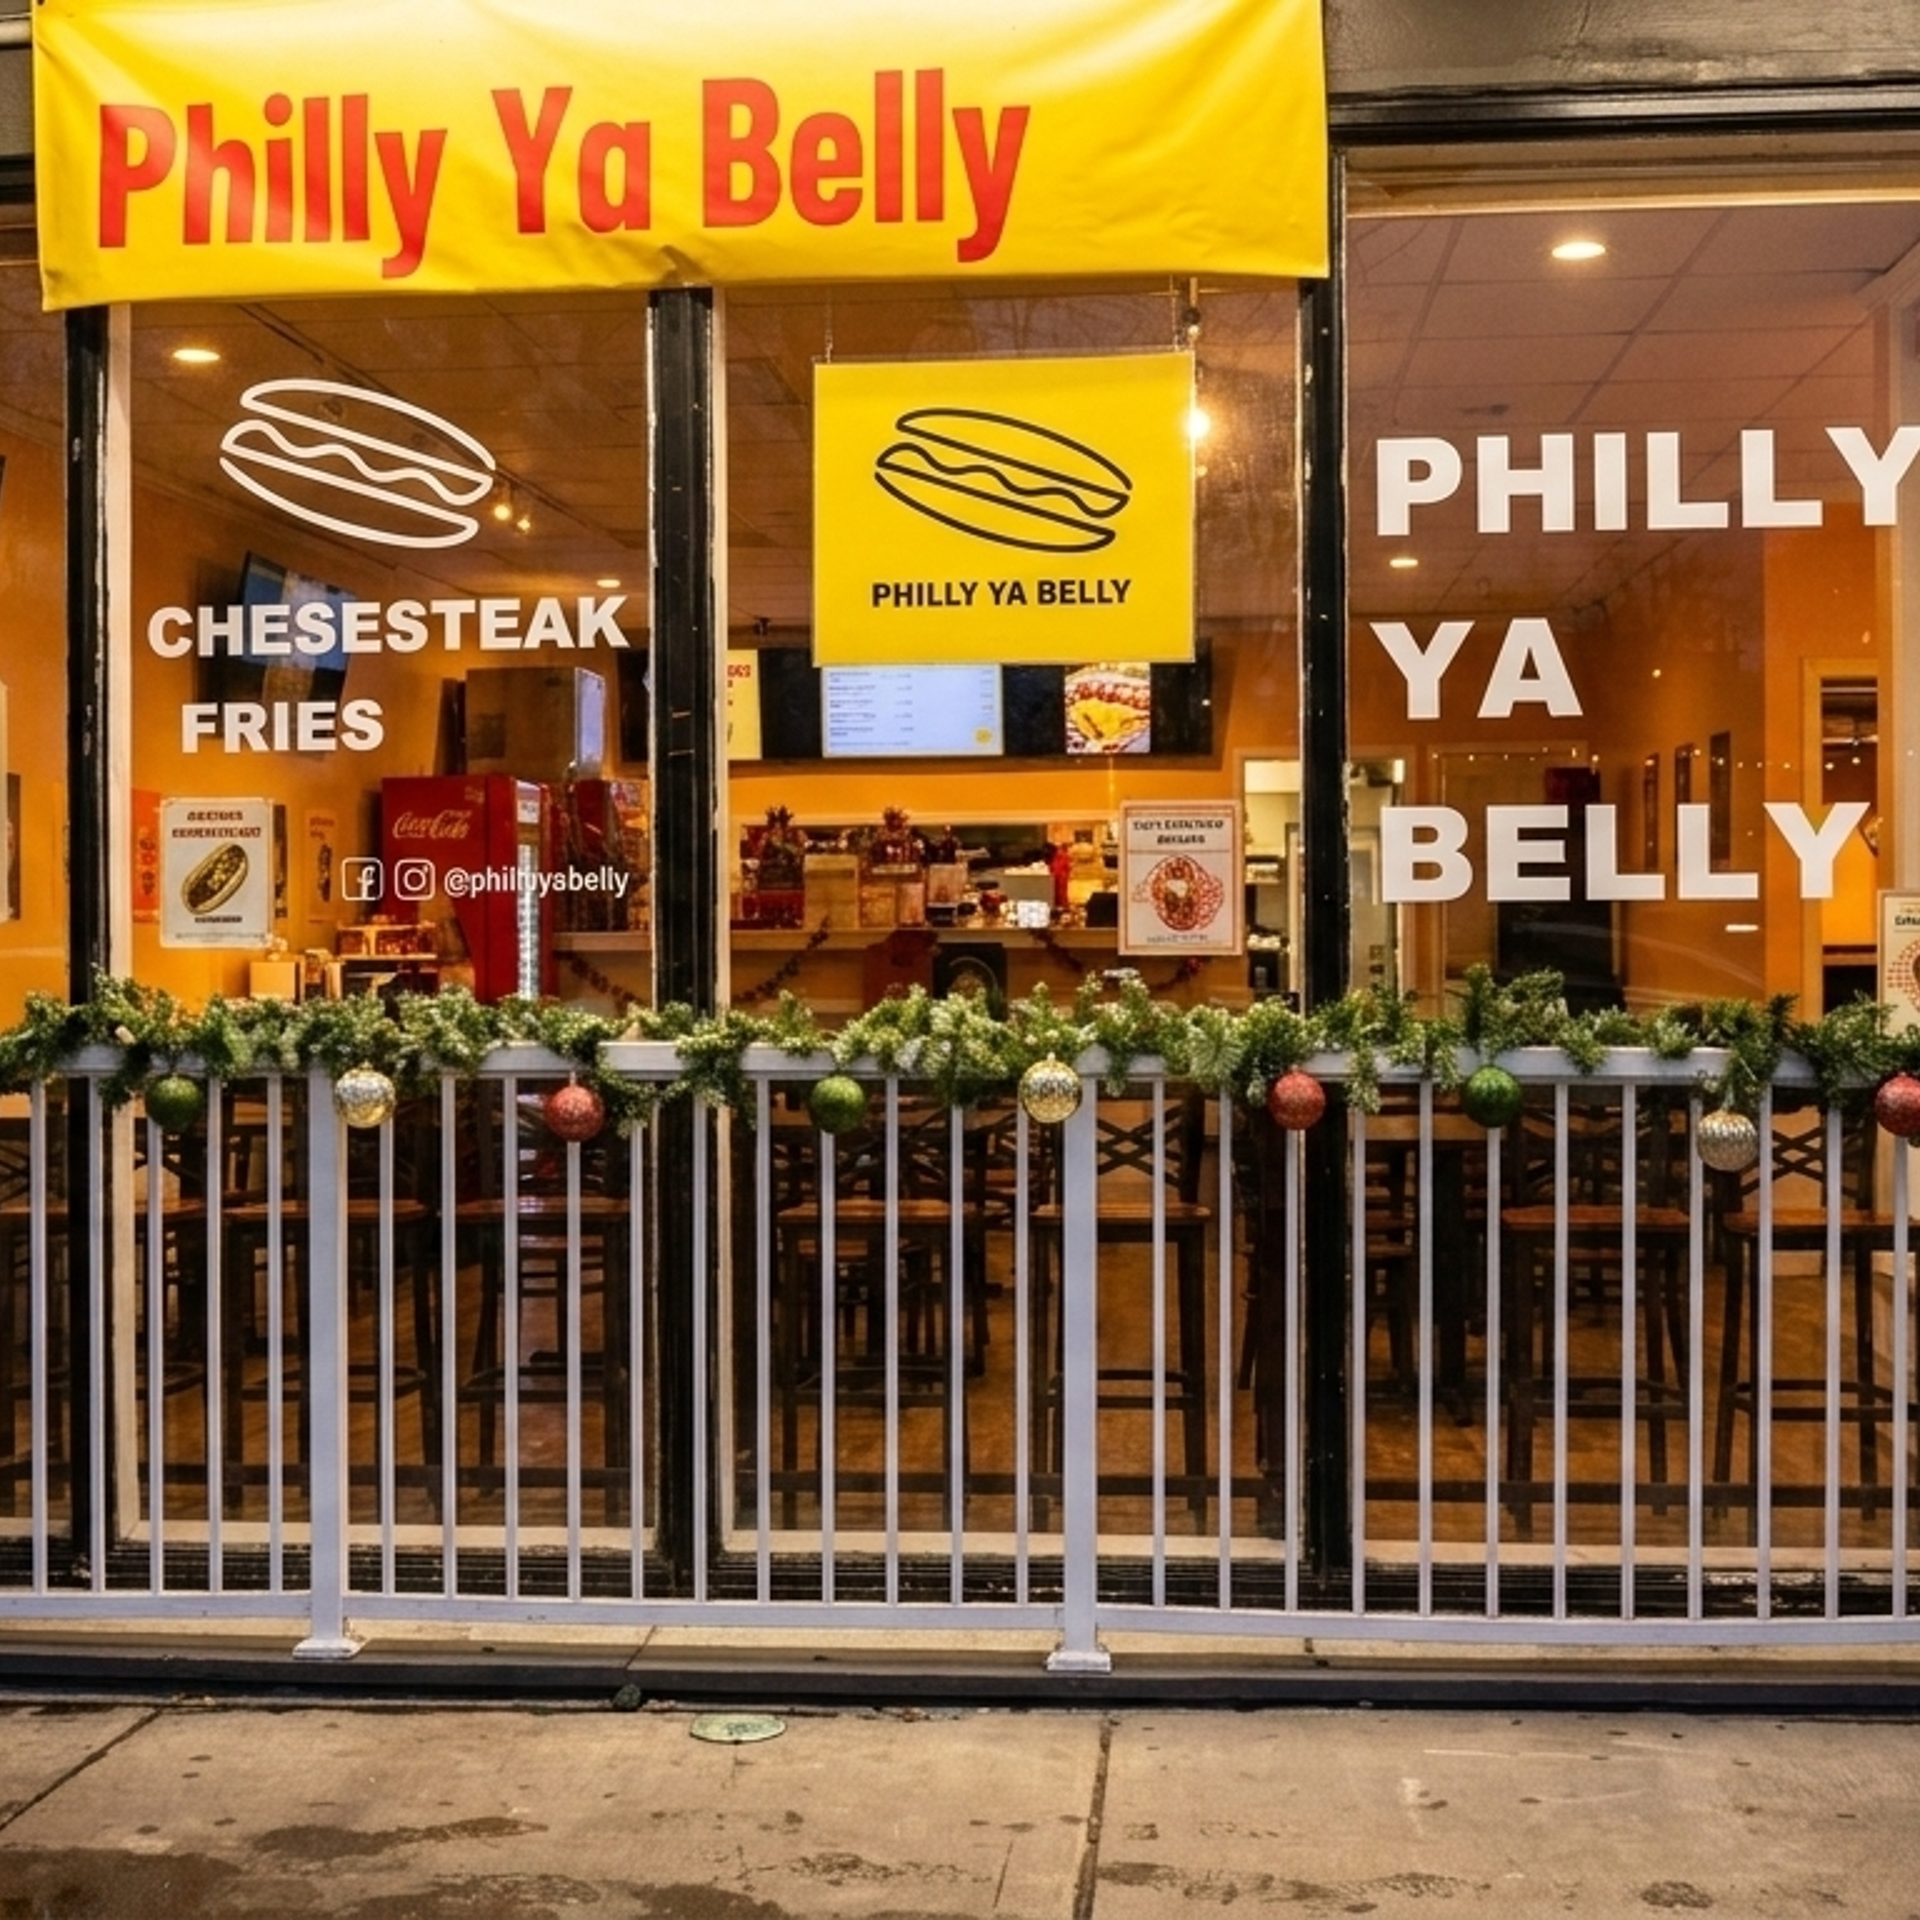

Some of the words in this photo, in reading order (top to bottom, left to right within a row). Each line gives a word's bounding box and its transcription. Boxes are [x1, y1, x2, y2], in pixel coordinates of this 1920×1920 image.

[99, 92, 447, 279] Philly
[491, 85, 651, 234] Ya
[702, 67, 1031, 263] Belly
[1375, 425, 1920, 537] PHILLY
[146, 594, 630, 659] CHESESTEAK
[871, 581, 979, 608] PHILLY
[988, 580, 1027, 606] YA
[1037, 578, 1132, 605] BELLY
[1370, 617, 1584, 720] YA
[181, 698, 385, 754] FRIES
[1380, 801, 1871, 904] BELLY
